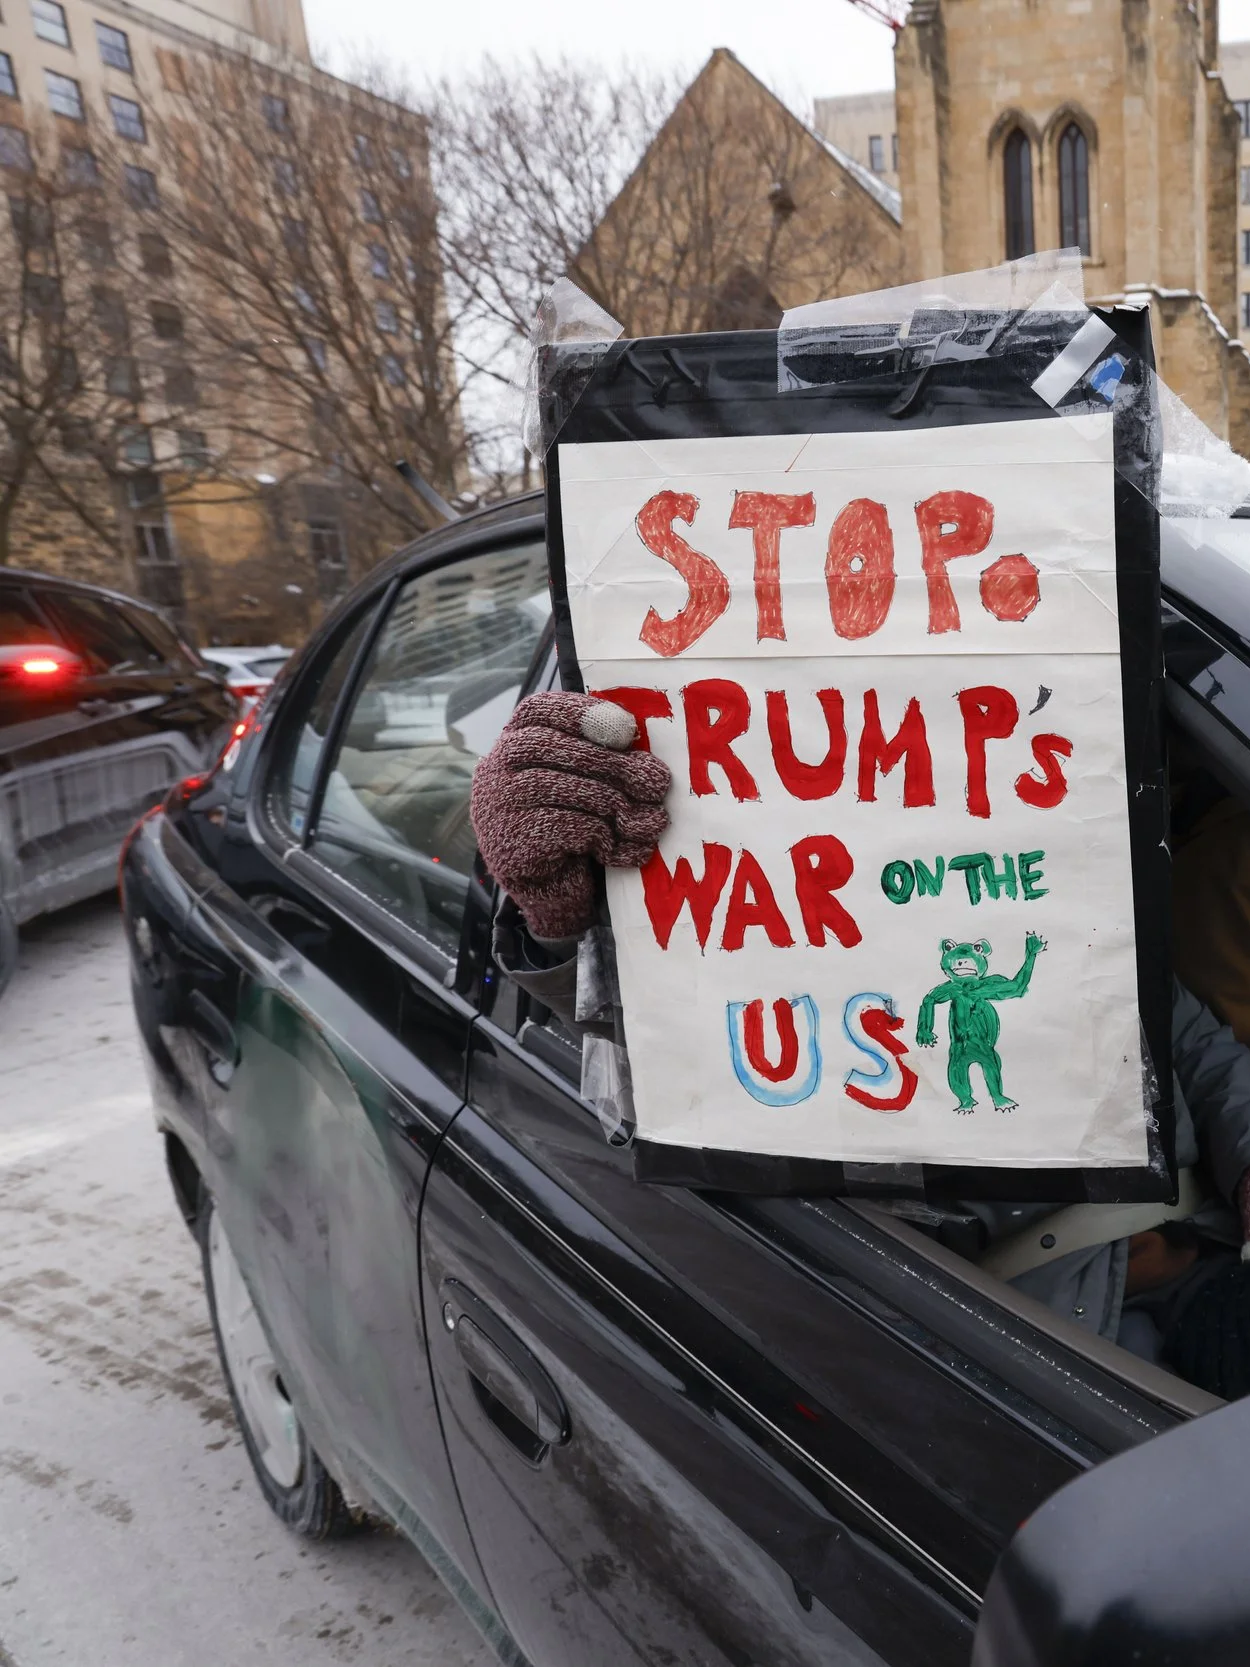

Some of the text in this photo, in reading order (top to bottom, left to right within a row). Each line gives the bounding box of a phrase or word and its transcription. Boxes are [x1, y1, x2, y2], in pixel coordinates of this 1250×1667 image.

[635, 488, 1041, 657] STOP.
[640, 833, 1051, 955] WAR ON THE
[727, 992, 919, 1111] US
